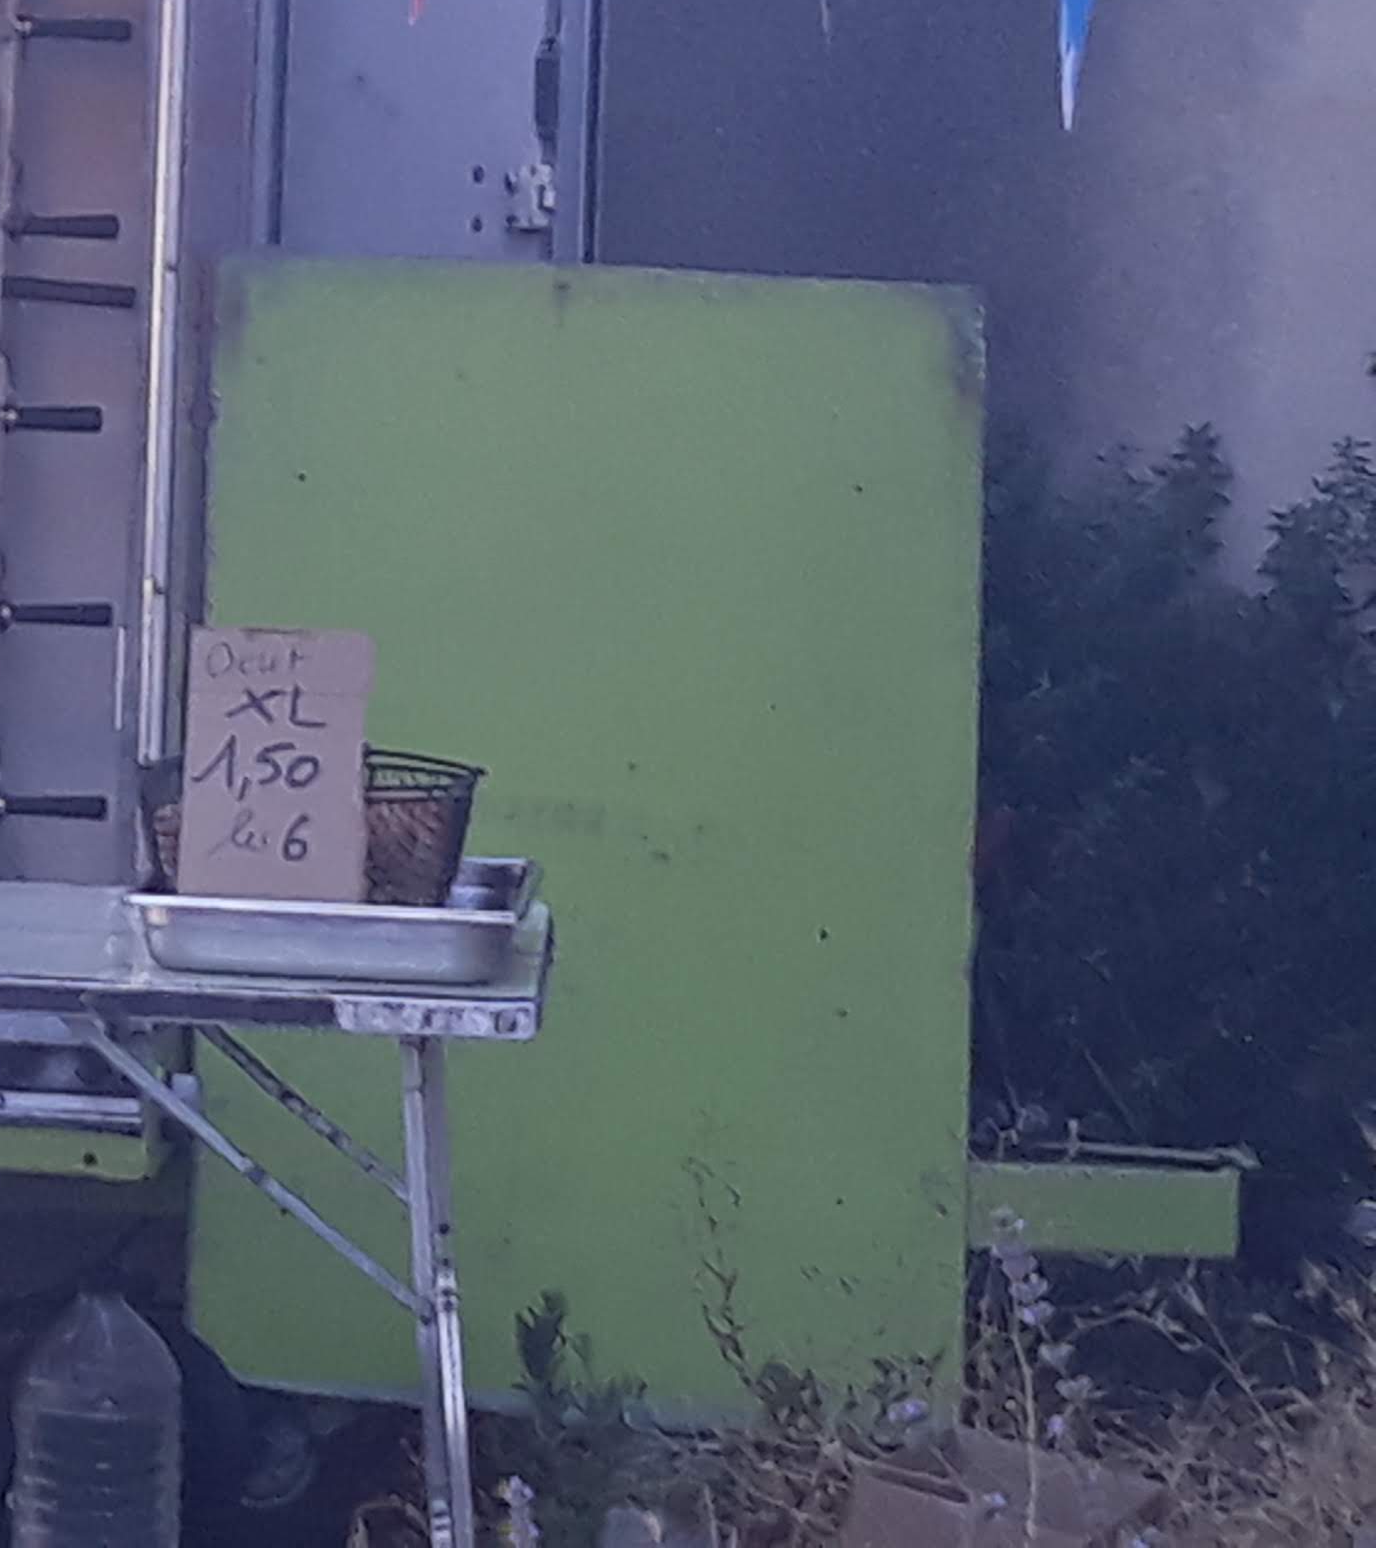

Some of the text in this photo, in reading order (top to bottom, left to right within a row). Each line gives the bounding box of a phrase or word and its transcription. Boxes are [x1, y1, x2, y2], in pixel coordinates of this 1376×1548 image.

[225, 685, 327, 728] XL
[191, 734, 321, 802] 1,50
[282, 814, 309, 862] 6
